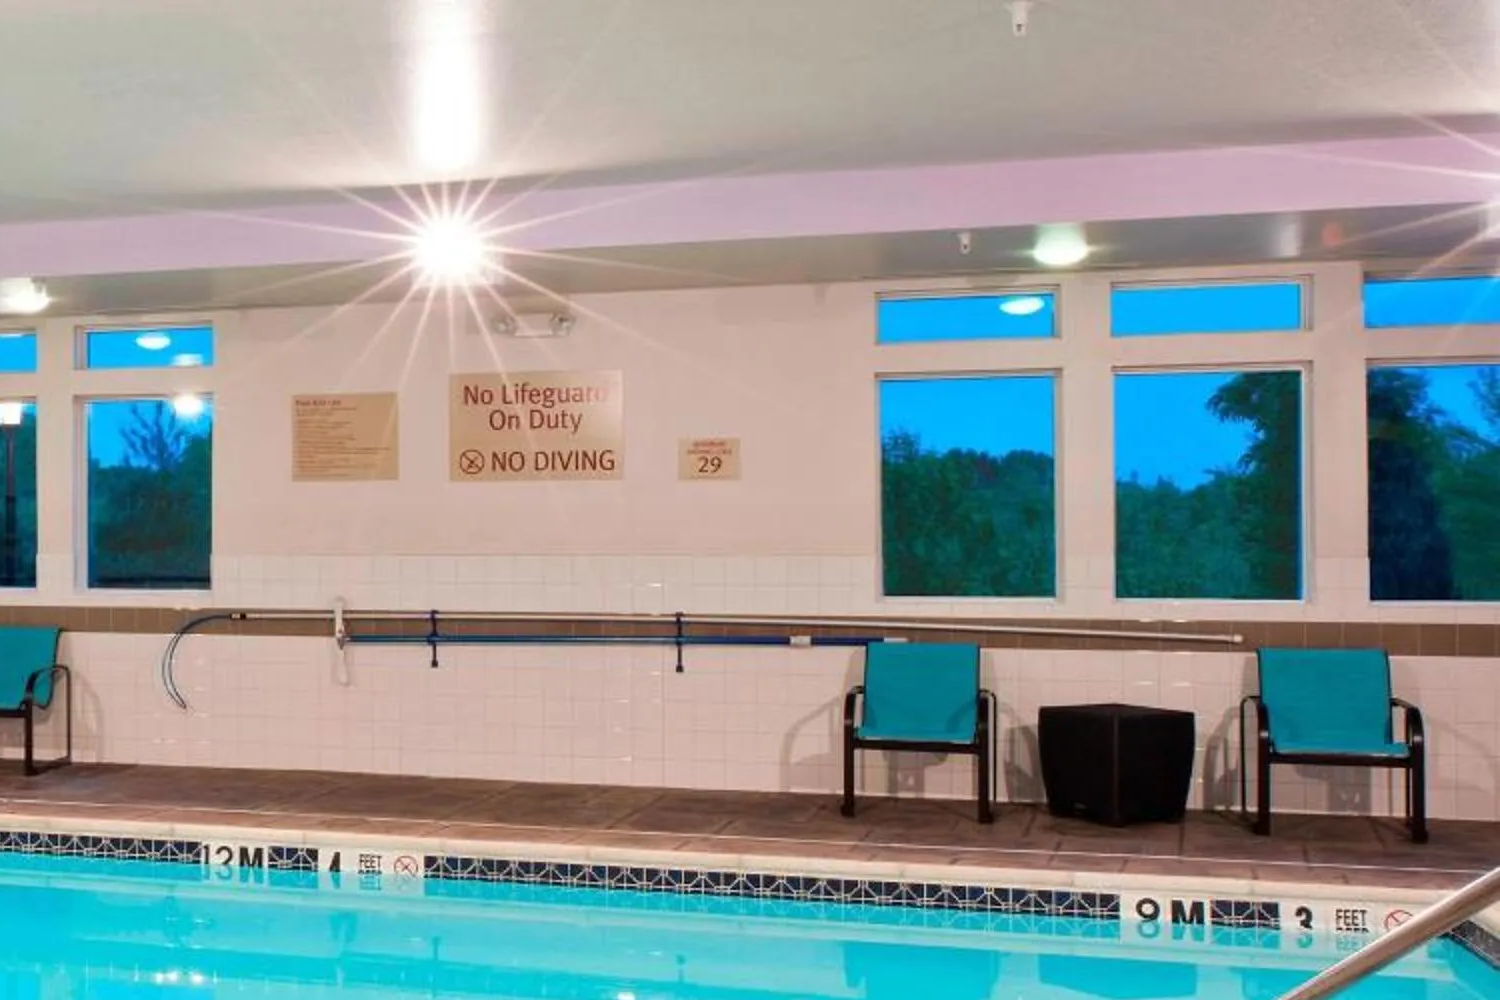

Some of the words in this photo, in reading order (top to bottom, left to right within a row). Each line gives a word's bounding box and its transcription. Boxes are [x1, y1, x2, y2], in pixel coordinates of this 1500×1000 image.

[464, 384, 493, 405] No
[489, 409, 520, 431] On
[529, 409, 583, 435] Duty
[491, 450, 525, 472] NO
[534, 450, 616, 472] DIVING
[697, 455, 722, 473] 29
[1335, 909, 1367, 927] FEET
